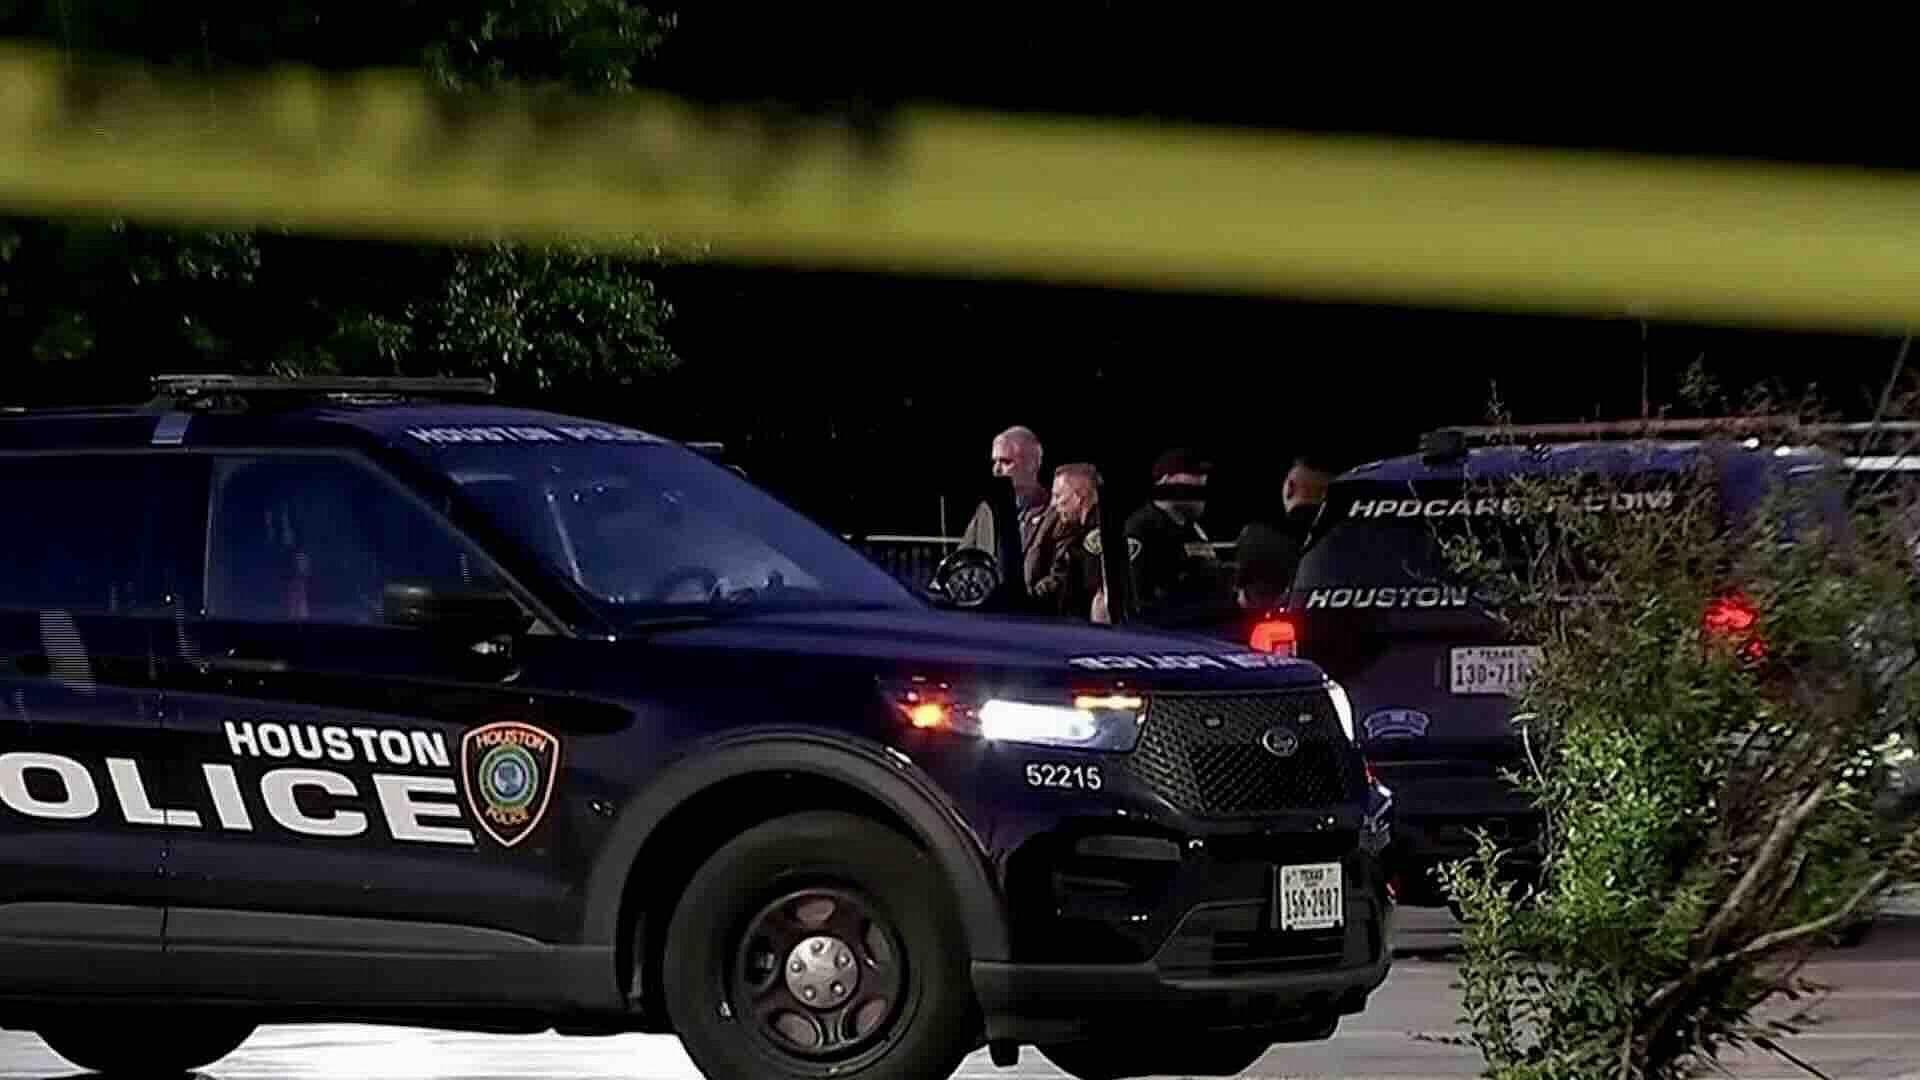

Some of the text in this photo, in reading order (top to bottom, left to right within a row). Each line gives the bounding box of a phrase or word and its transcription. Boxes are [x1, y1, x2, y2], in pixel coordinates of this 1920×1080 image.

[1306, 585, 1468, 609] HOUSTON
[224, 720, 452, 767] HOUSTON
[476, 729, 548, 753] HOUSTON
[1026, 763, 1102, 790] 52215
